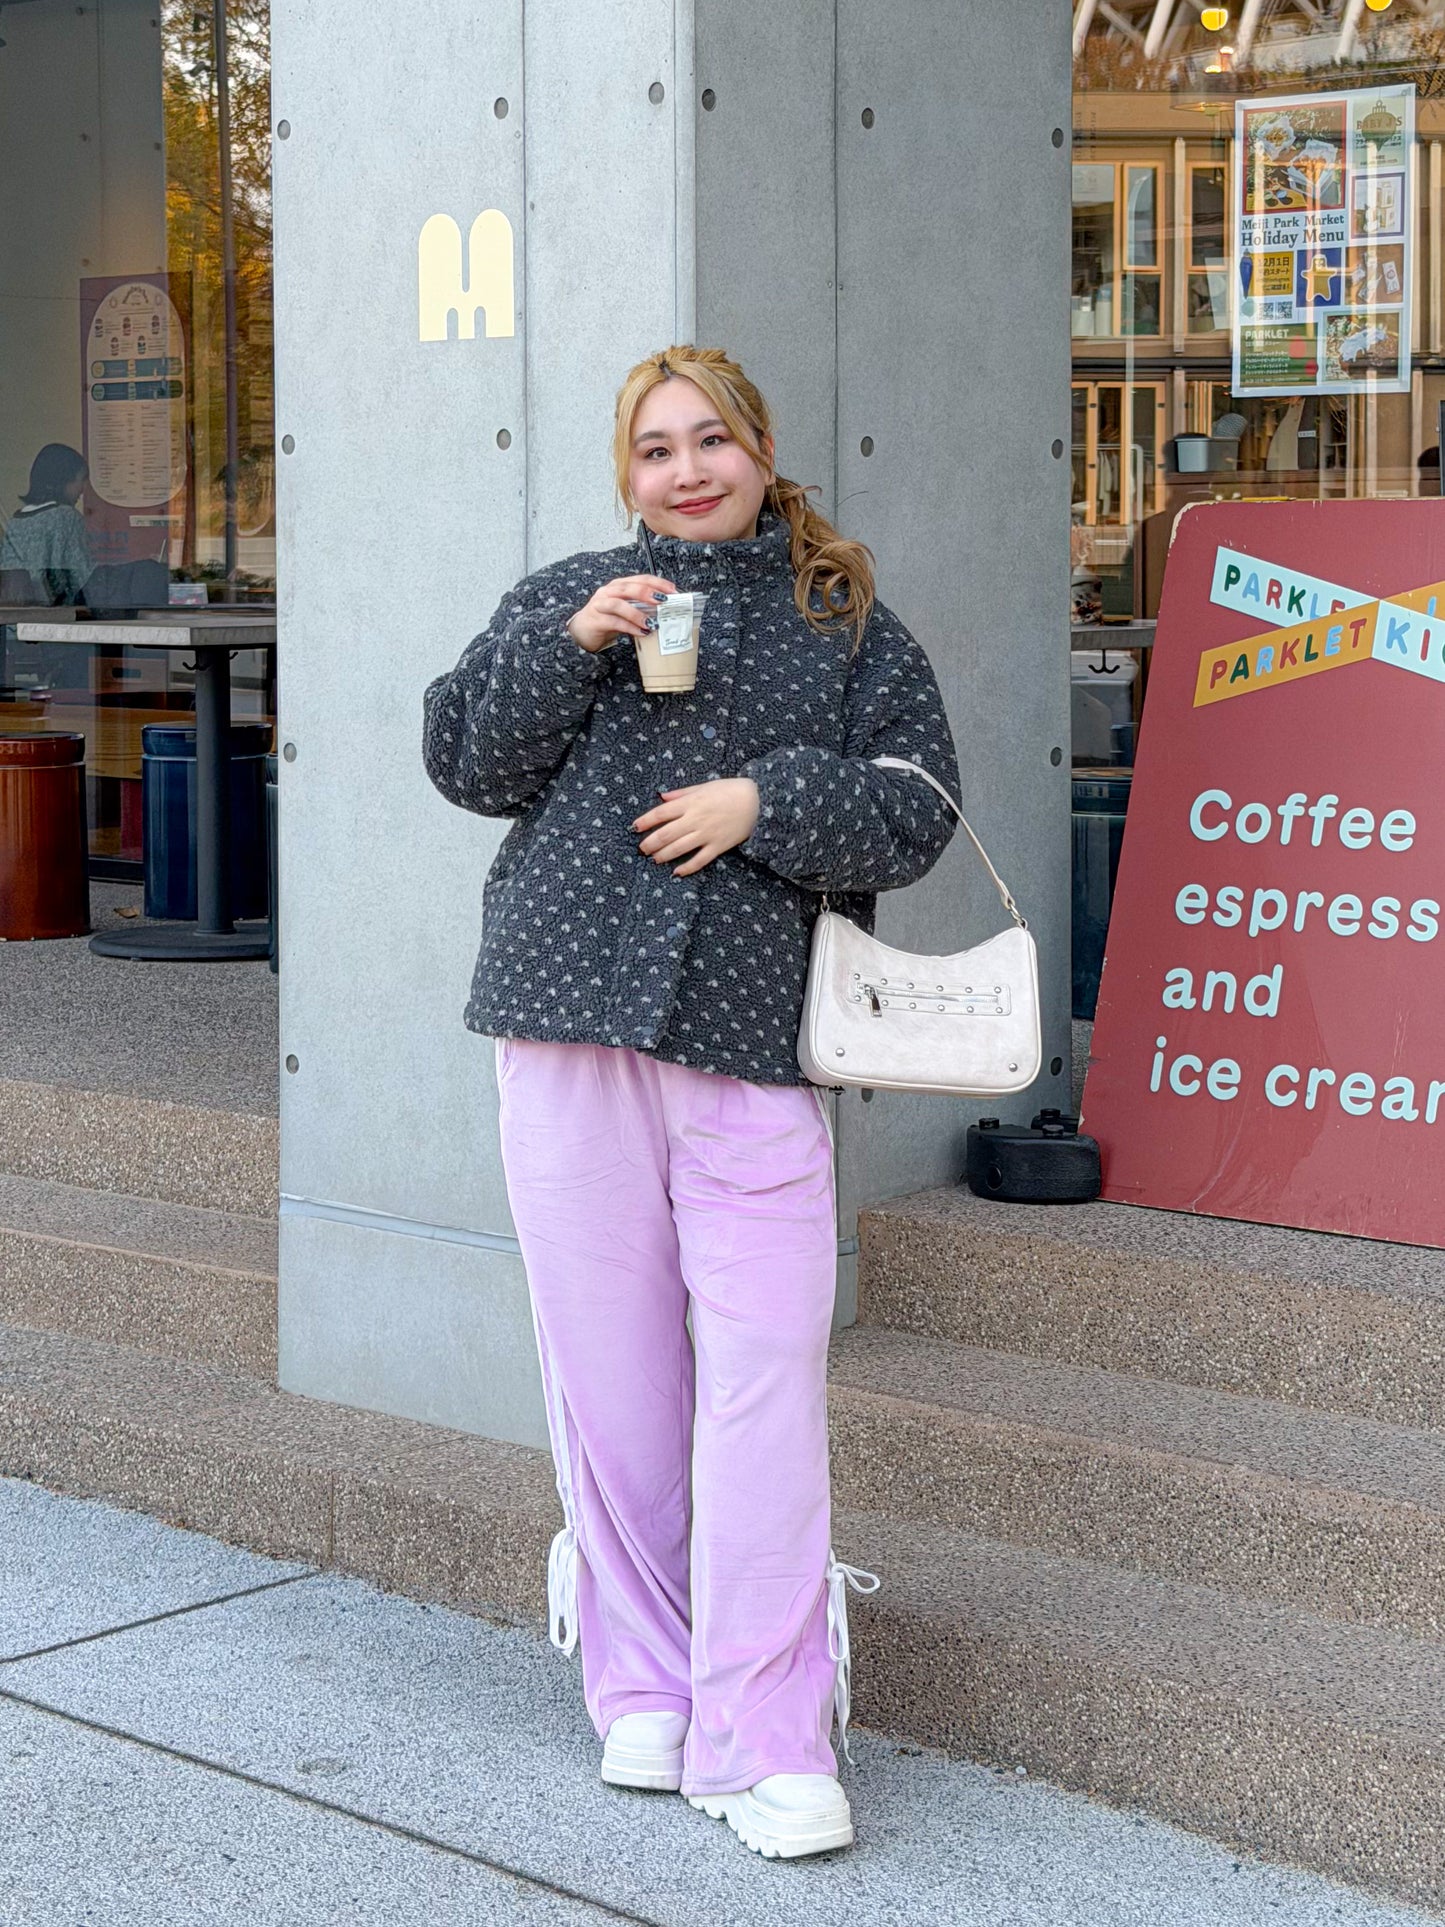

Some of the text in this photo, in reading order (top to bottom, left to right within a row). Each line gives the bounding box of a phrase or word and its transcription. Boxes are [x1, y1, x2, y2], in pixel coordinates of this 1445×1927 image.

[1241, 214, 1345, 232] Meiji Park Market
[1241, 228, 1345, 249] Holiday Menu
[1245, 328, 1290, 340] PARKLET
[1210, 618, 1368, 690] PARKLET
[1386, 616, 1445, 666] KI
[1189, 789, 1417, 852] Coffee
[1174, 883, 1441, 942] espress
[1162, 963, 1284, 1018] and
[1149, 1035, 1242, 1101] ice
